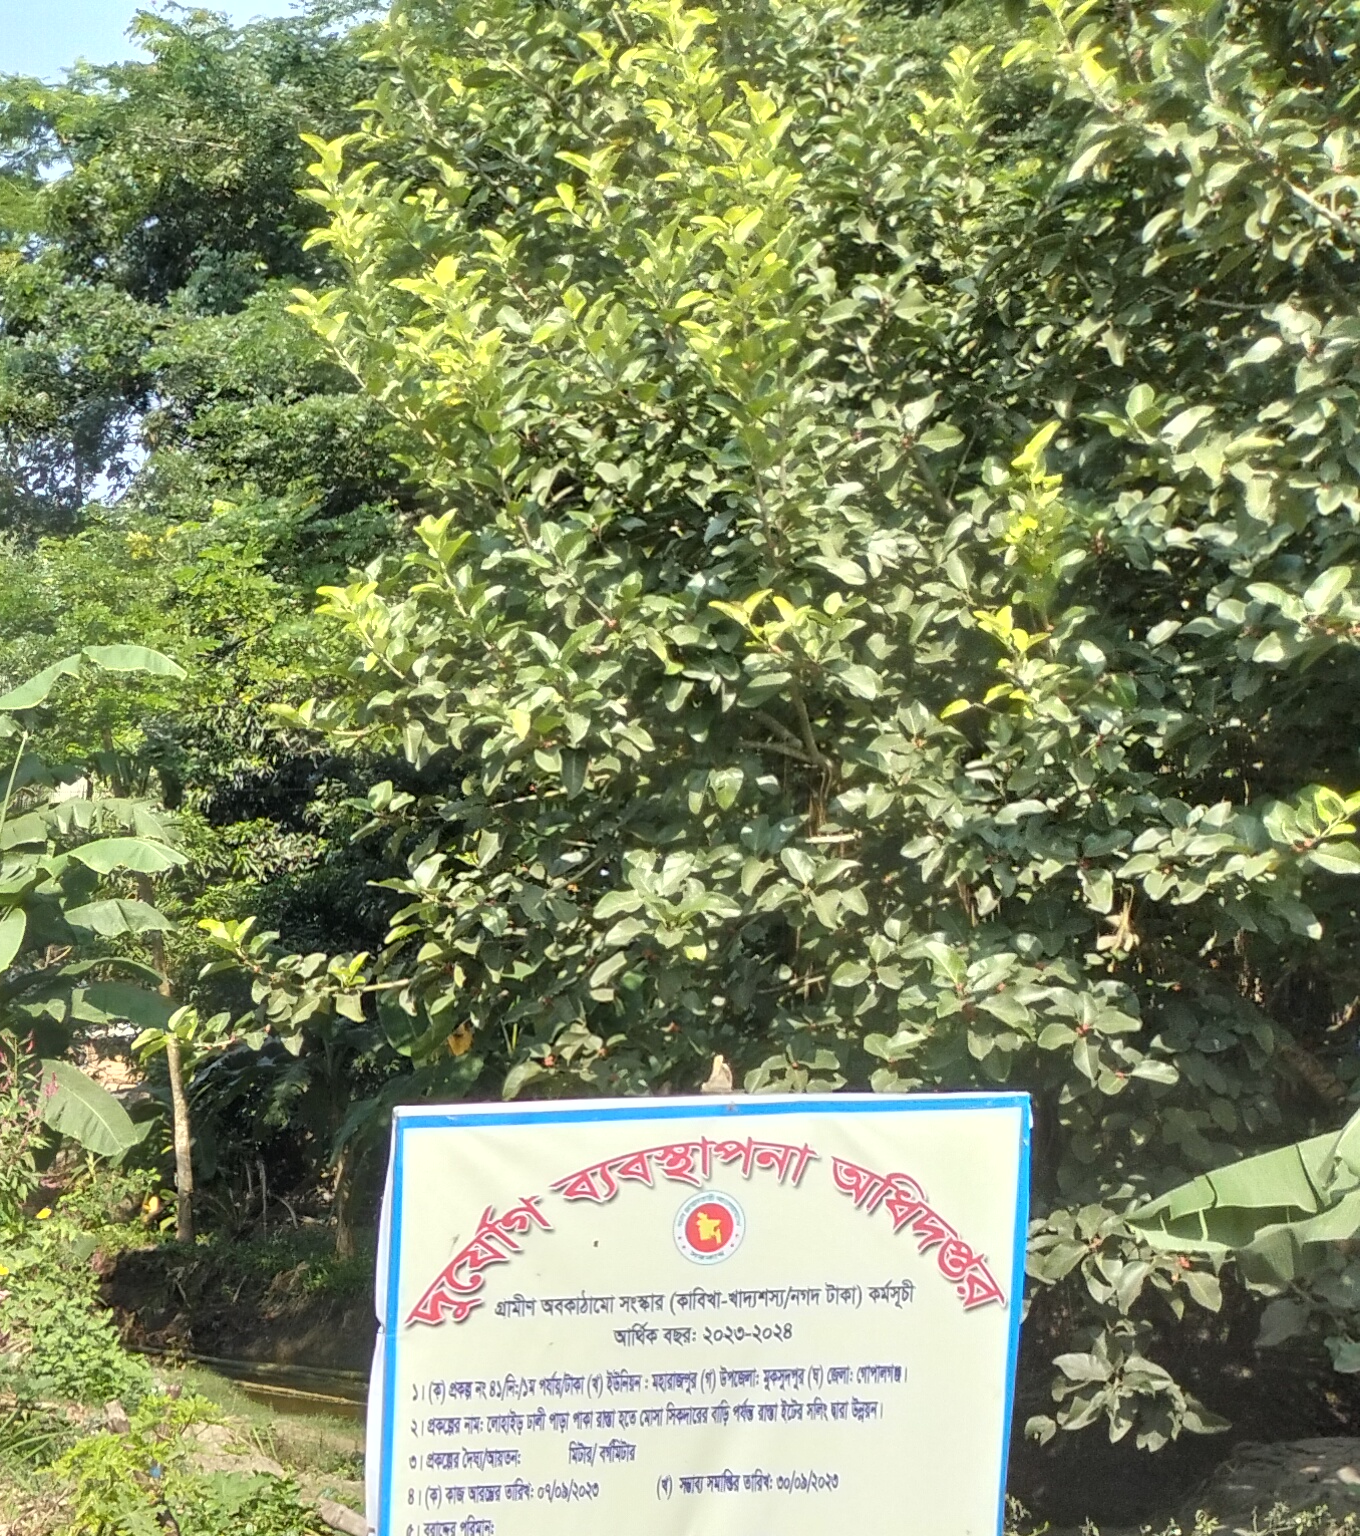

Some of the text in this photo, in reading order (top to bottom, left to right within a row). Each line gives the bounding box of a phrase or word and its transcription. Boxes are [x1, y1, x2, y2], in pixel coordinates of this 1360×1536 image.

[405, 1136, 1007, 1327] দুর্যোগ ব্যবস্থাপনা অধিদপ্তর
[495, 1293, 536, 1318] গ্রামীণ
[540, 1290, 615, 1315] অবকাঠামো
[619, 1293, 664, 1314] সংস্কার
[825, 1282, 862, 1309] টাকা)
[868, 1279, 916, 1309] কর্মসূচী
[613, 1322, 792, 1347] আর্থিক ২০২৩-২০২৪
[429, 1380, 445, 1405] (ক)
[449, 1381, 473, 1400] প্রকল্প
[475, 1381, 487, 1399] নং
[587, 1374, 603, 1399] (খ)
[606, 1369, 642, 1395] ইউনিয়ন
[652, 1372, 698, 1395] মহারাজপুর
[701, 1369, 716, 1394] (গ)
[808, 1365, 823, 1390] (ঘ)
[427, 1417, 461, 1436] প্রকল্পের
[549, 1412, 570, 1433] পাড়া
[573, 1411, 593, 1429] পাকা
[596, 1409, 616, 1428] রাস্তা
[618, 1410, 637, 1430] হতে
[666, 1402, 709, 1425] সিকদারের
[711, 1399, 730, 1426] বাড়ি
[733, 1398, 755, 1422] পর্যন্ত
[758, 1403, 778, 1422] রাস্তা
[781, 1398, 804, 1421] ইটের
[831, 1401, 849, 1420] দ্বারা
[426, 1452, 460, 1470] প্রকল্পের
[599, 1439, 636, 1463] বর্গমিটার
[425, 1485, 442, 1510] (ক)
[445, 1487, 465, 1504] কাজ
[538, 1479, 599, 1503] ০৭/০৯/২০২৩
[657, 1475, 672, 1500] (খ)
[776, 1470, 838, 1494] ৩০/০৯/২০২৩
